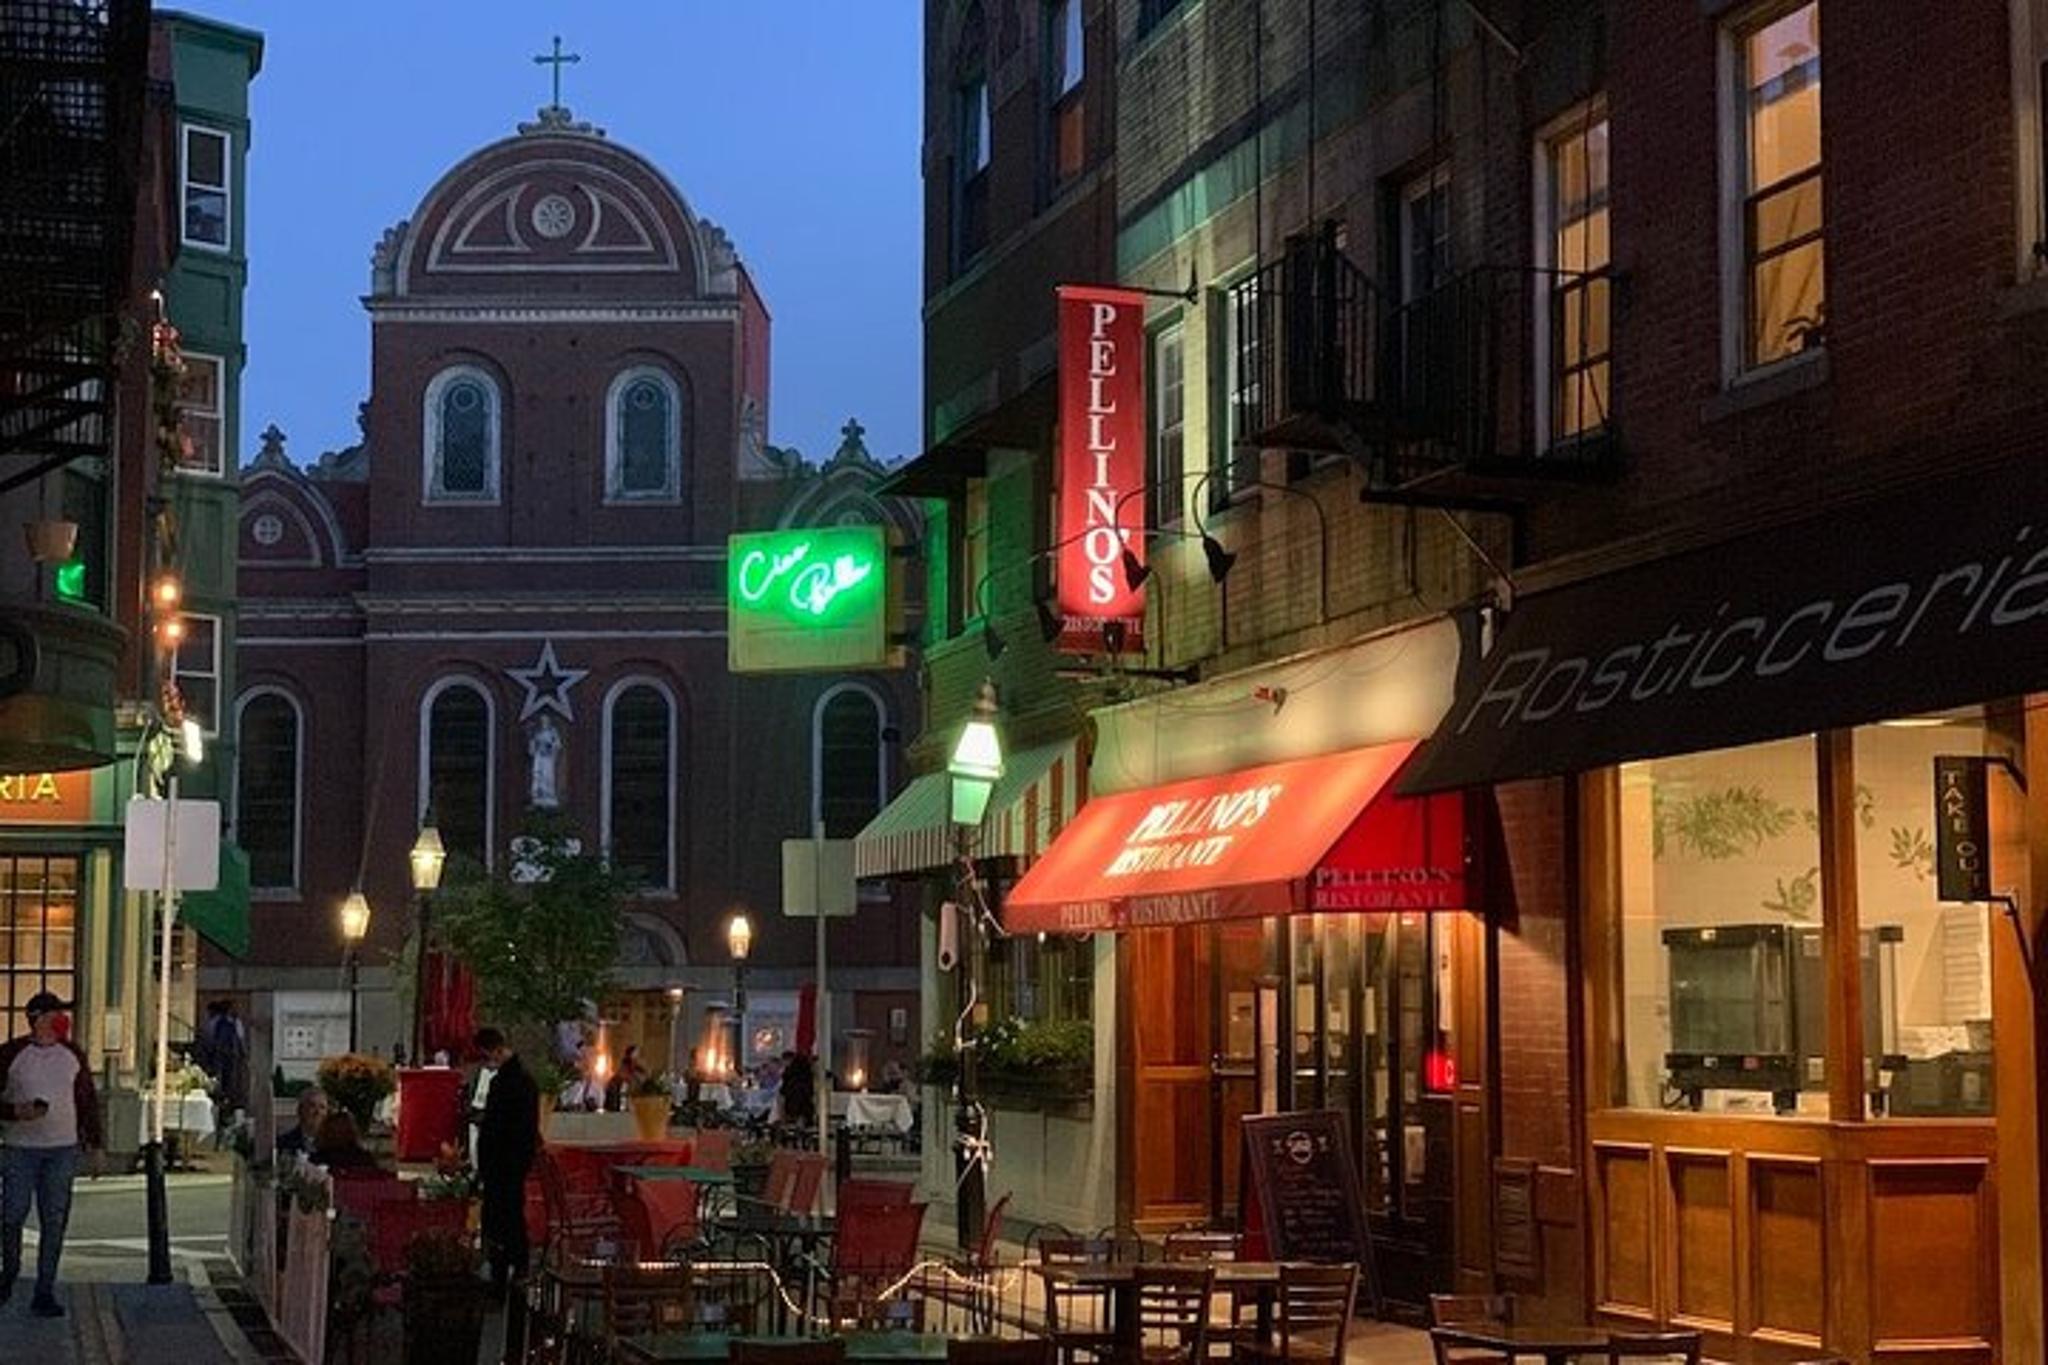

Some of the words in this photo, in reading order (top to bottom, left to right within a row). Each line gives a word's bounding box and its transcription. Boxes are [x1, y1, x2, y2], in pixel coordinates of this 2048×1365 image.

[1084, 303, 1130, 604] PELLINO'S
[1457, 524, 2048, 735] Rosticceria
[1943, 769, 1967, 834] TAKE
